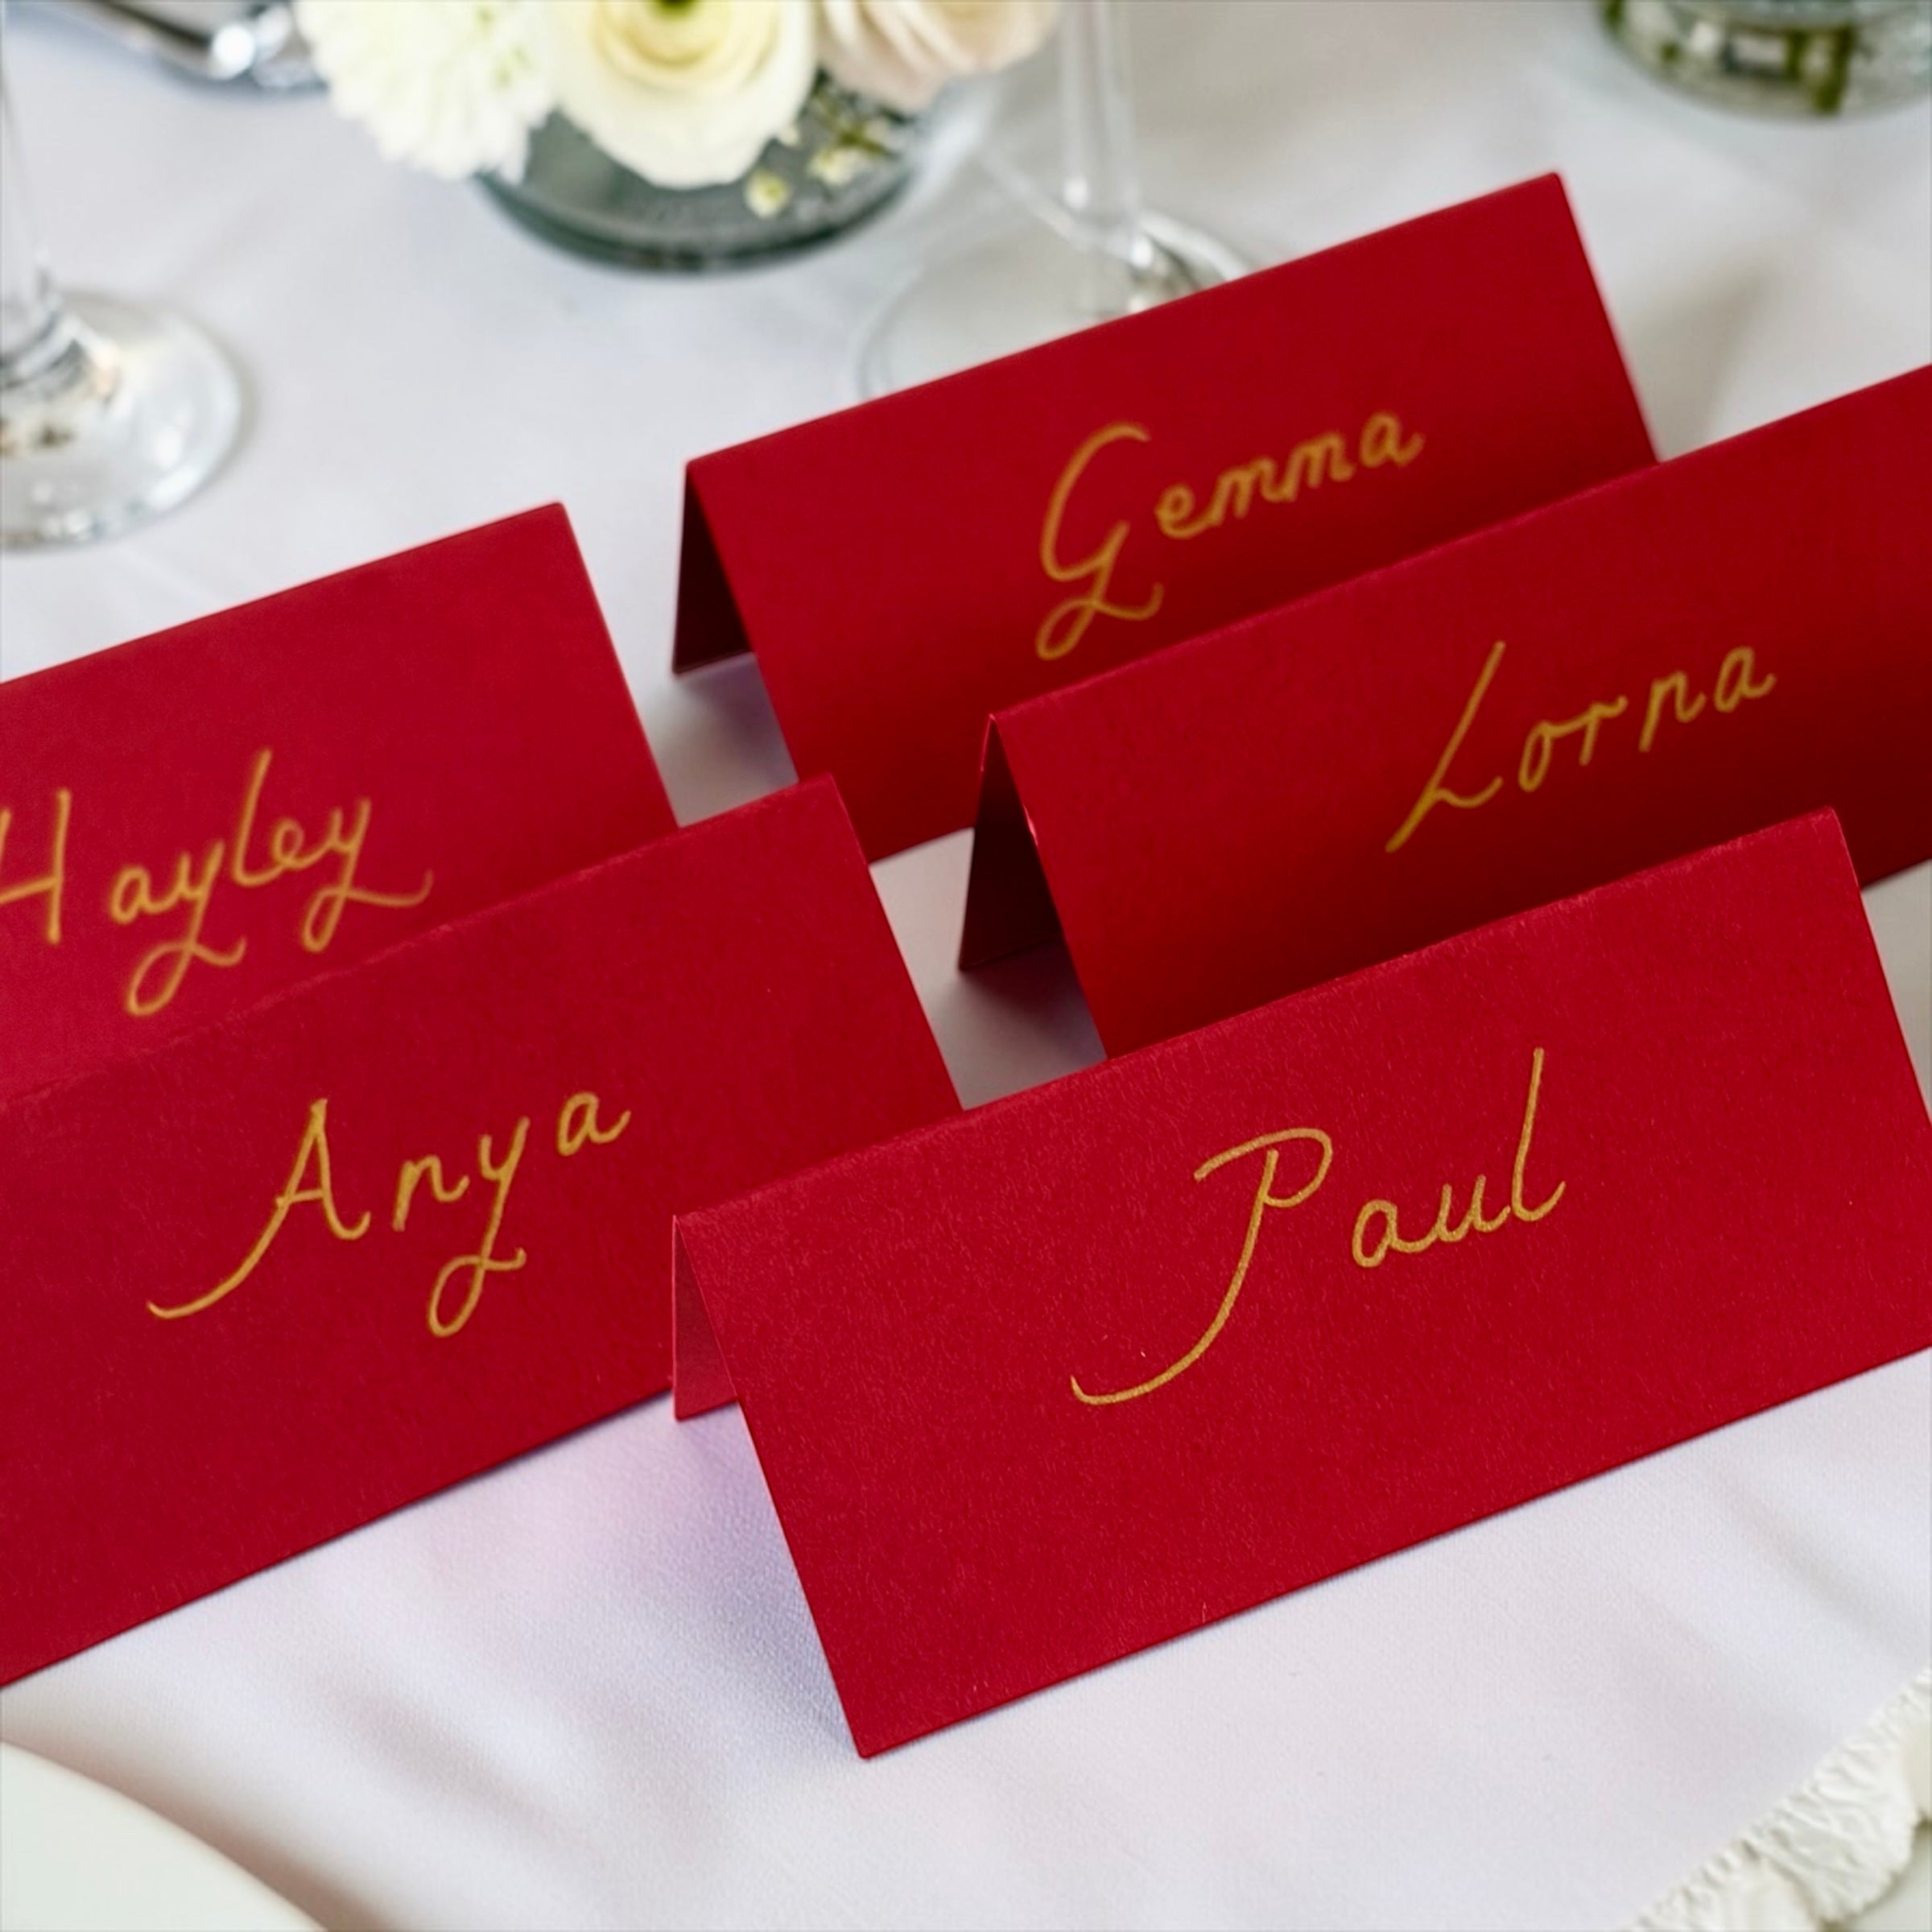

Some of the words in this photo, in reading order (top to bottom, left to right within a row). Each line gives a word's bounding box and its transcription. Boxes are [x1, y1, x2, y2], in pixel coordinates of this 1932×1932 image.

[1034, 411, 1424, 661] Gemma
[1385, 641, 1777, 852] Lorna
[0, 749, 433, 1017] Hayley
[146, 1090, 631, 1337] Anya
[1070, 1046, 1567, 1406] Paul
